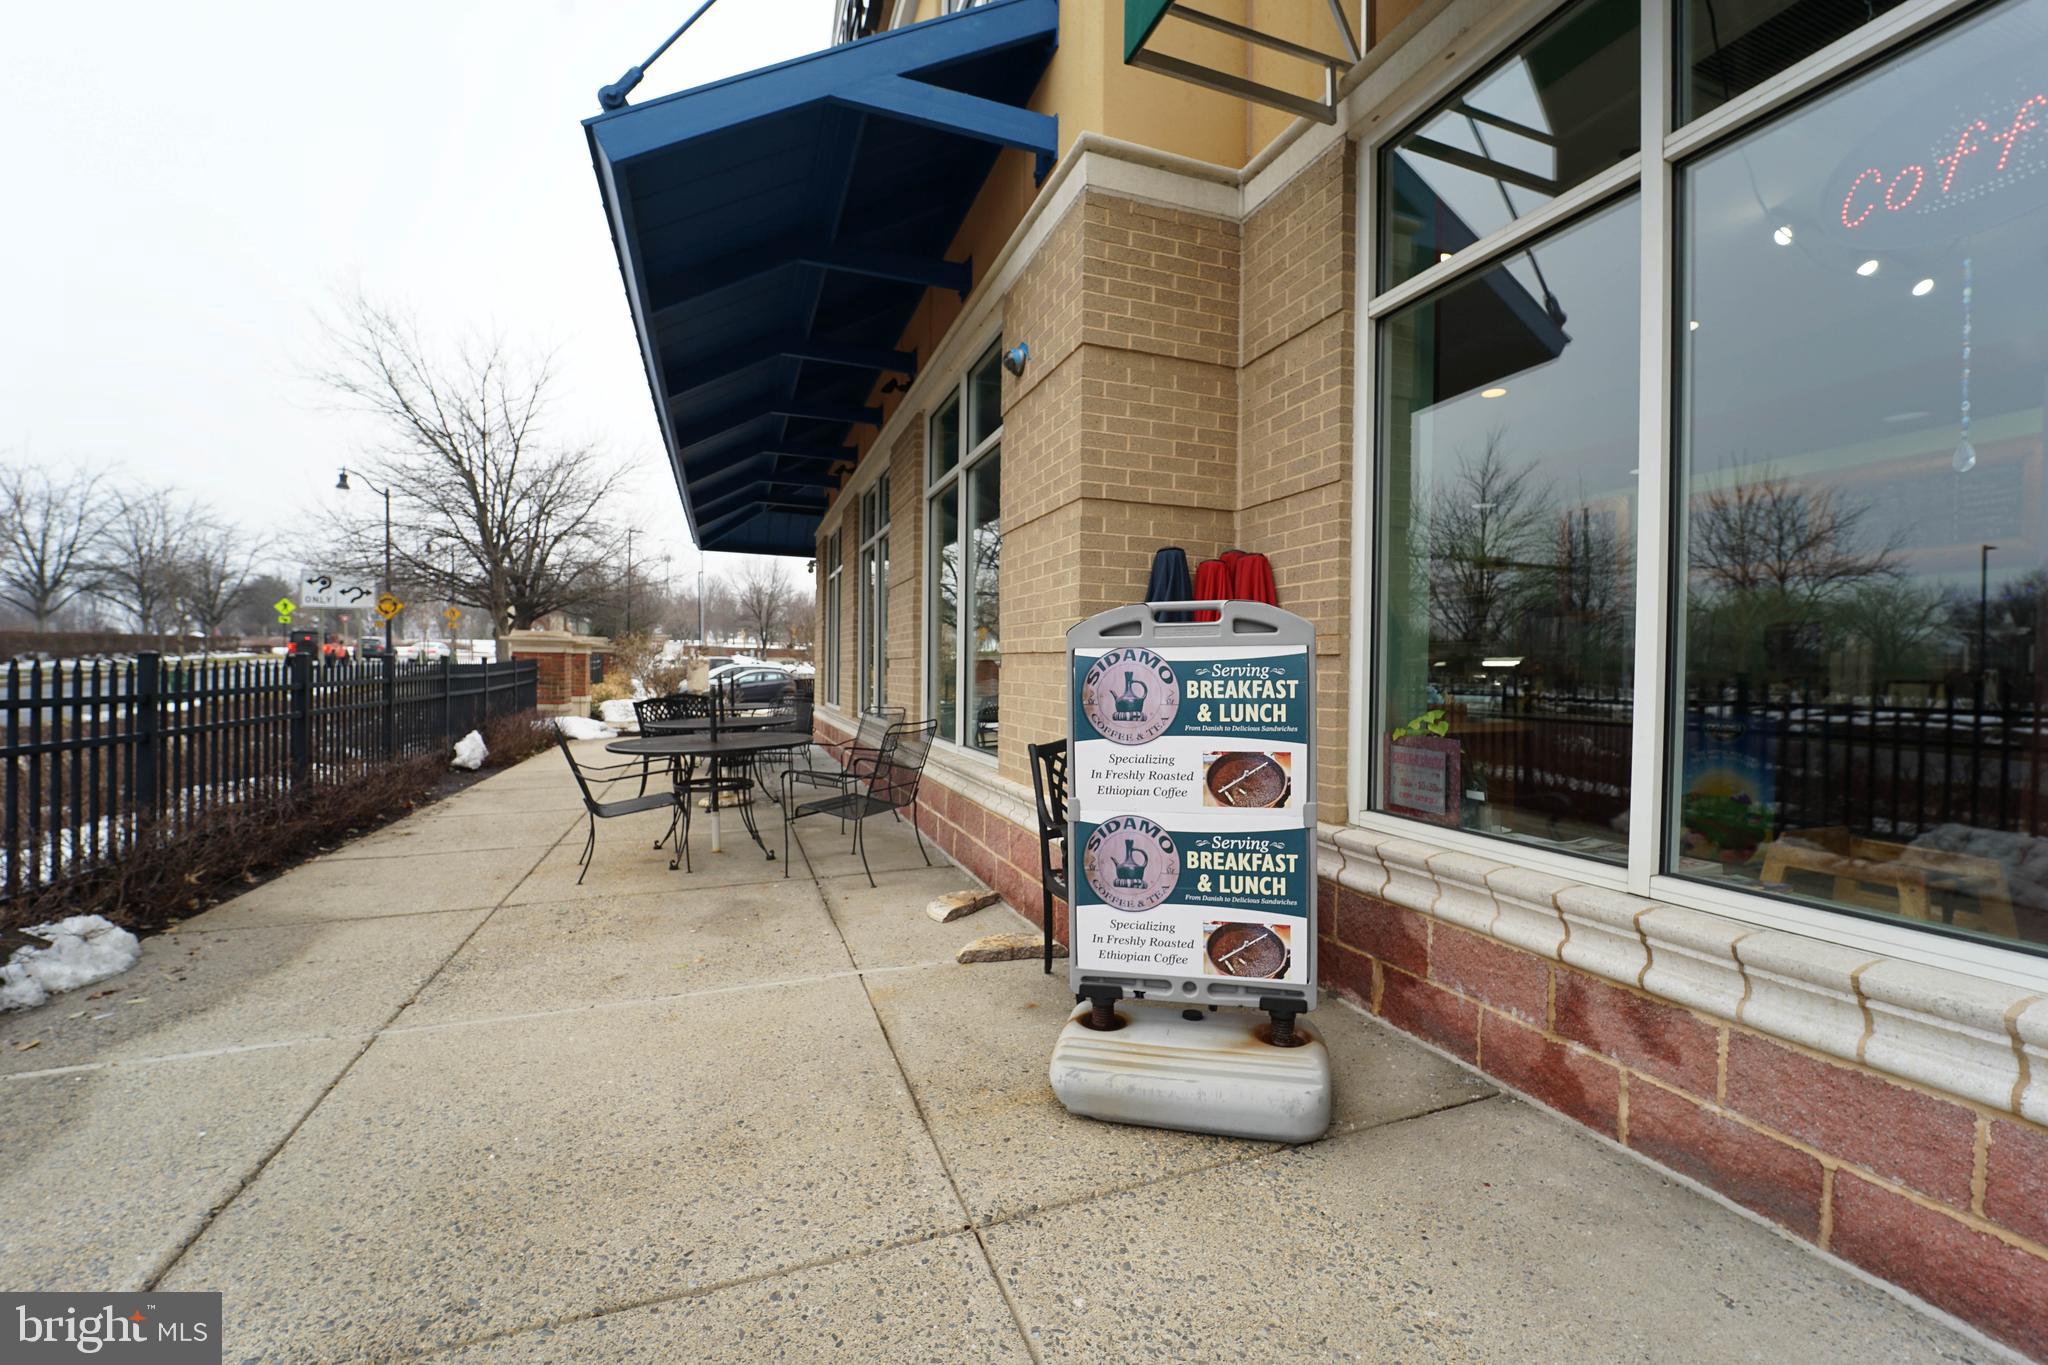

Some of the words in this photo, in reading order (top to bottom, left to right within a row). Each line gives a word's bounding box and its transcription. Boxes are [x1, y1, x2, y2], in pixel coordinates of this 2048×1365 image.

[304, 595, 332, 605] ONLY
[1086, 648, 1174, 686] SIDAMO
[1211, 663, 1270, 680] Serving
[1186, 679, 1299, 699] BREAKFAST
[1196, 703, 1212, 723] &
[1219, 703, 1287, 723] LUNCH
[1091, 712, 1135, 742] COFFEE
[1136, 732, 1145, 741] &
[1145, 716, 1170, 736] TEA
[1184, 724, 1201, 732] From
[1201, 724, 1224, 732] Danish
[1231, 725, 1260, 733] Delicious
[1261, 725, 1298, 733] Sandwiches
[1108, 753, 1176, 766] Specializing
[1091, 770, 1104, 779] In
[1105, 770, 1146, 782] Freshly
[1148, 770, 1194, 781] Roasted
[1097, 785, 1151, 799] Ethiopian
[1153, 787, 1188, 798] Coffee
[1087, 817, 1174, 855] SIDAMO
[1211, 835, 1270, 852] Serving
[1186, 851, 1299, 873] BREAKFAST
[1092, 878, 1135, 908] COFFEE
[1136, 899, 1145, 907] &
[1146, 884, 1171, 904] TEA
[1196, 873, 1212, 893] &
[1219, 874, 1287, 896] LUNCH
[1184, 894, 1201, 902] From
[1201, 895, 1224, 903] Danish
[1231, 896, 1260, 904] Delicious
[1260, 897, 1298, 906] Sandwiches
[1109, 919, 1176, 933] Specializing
[1092, 934, 1105, 944] In
[1106, 935, 1147, 947] Freshly
[1149, 937, 1195, 949] Roasted
[1098, 949, 1152, 963] Ethiopian
[1154, 952, 1189, 965] Coffee
